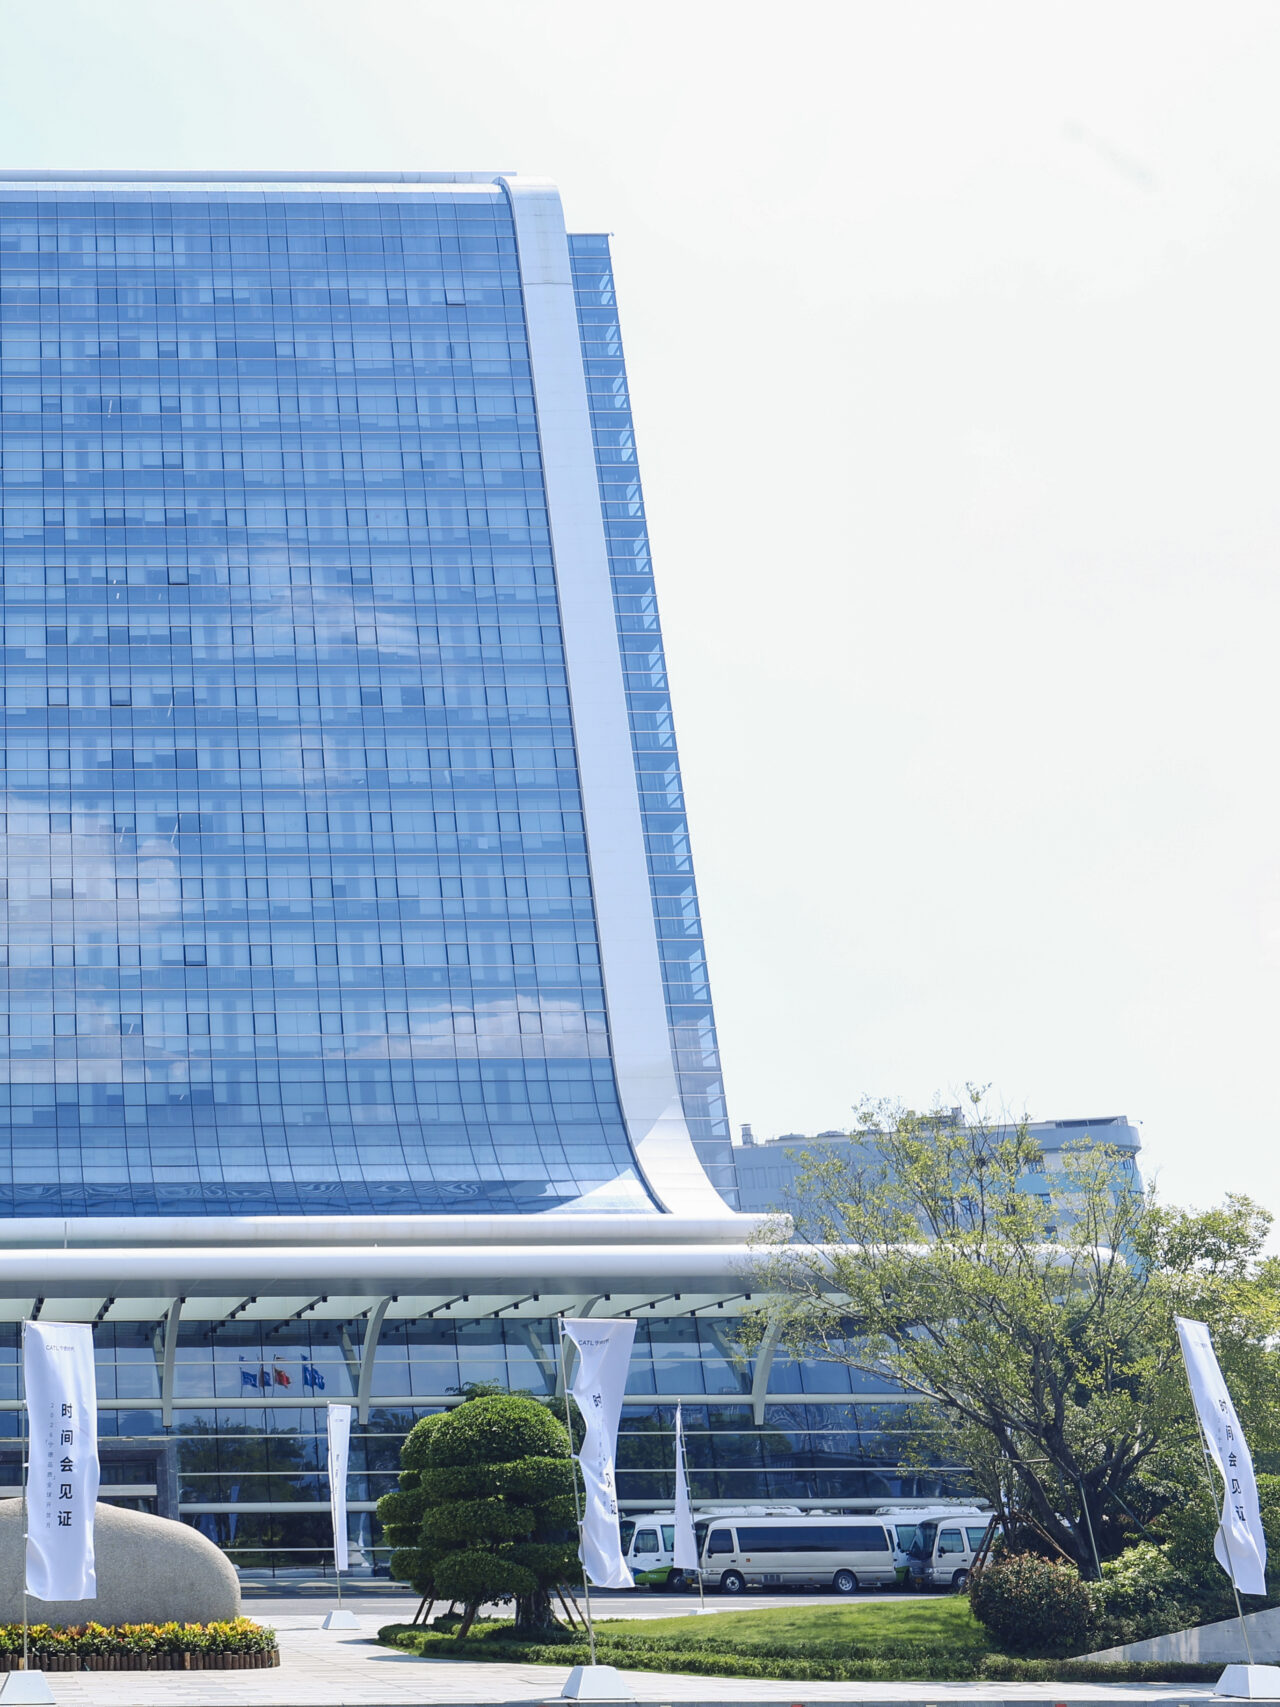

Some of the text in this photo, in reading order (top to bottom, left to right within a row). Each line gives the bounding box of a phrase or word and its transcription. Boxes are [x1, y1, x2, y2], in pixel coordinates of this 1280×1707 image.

[57, 1403, 74, 1527] 时间会见证
